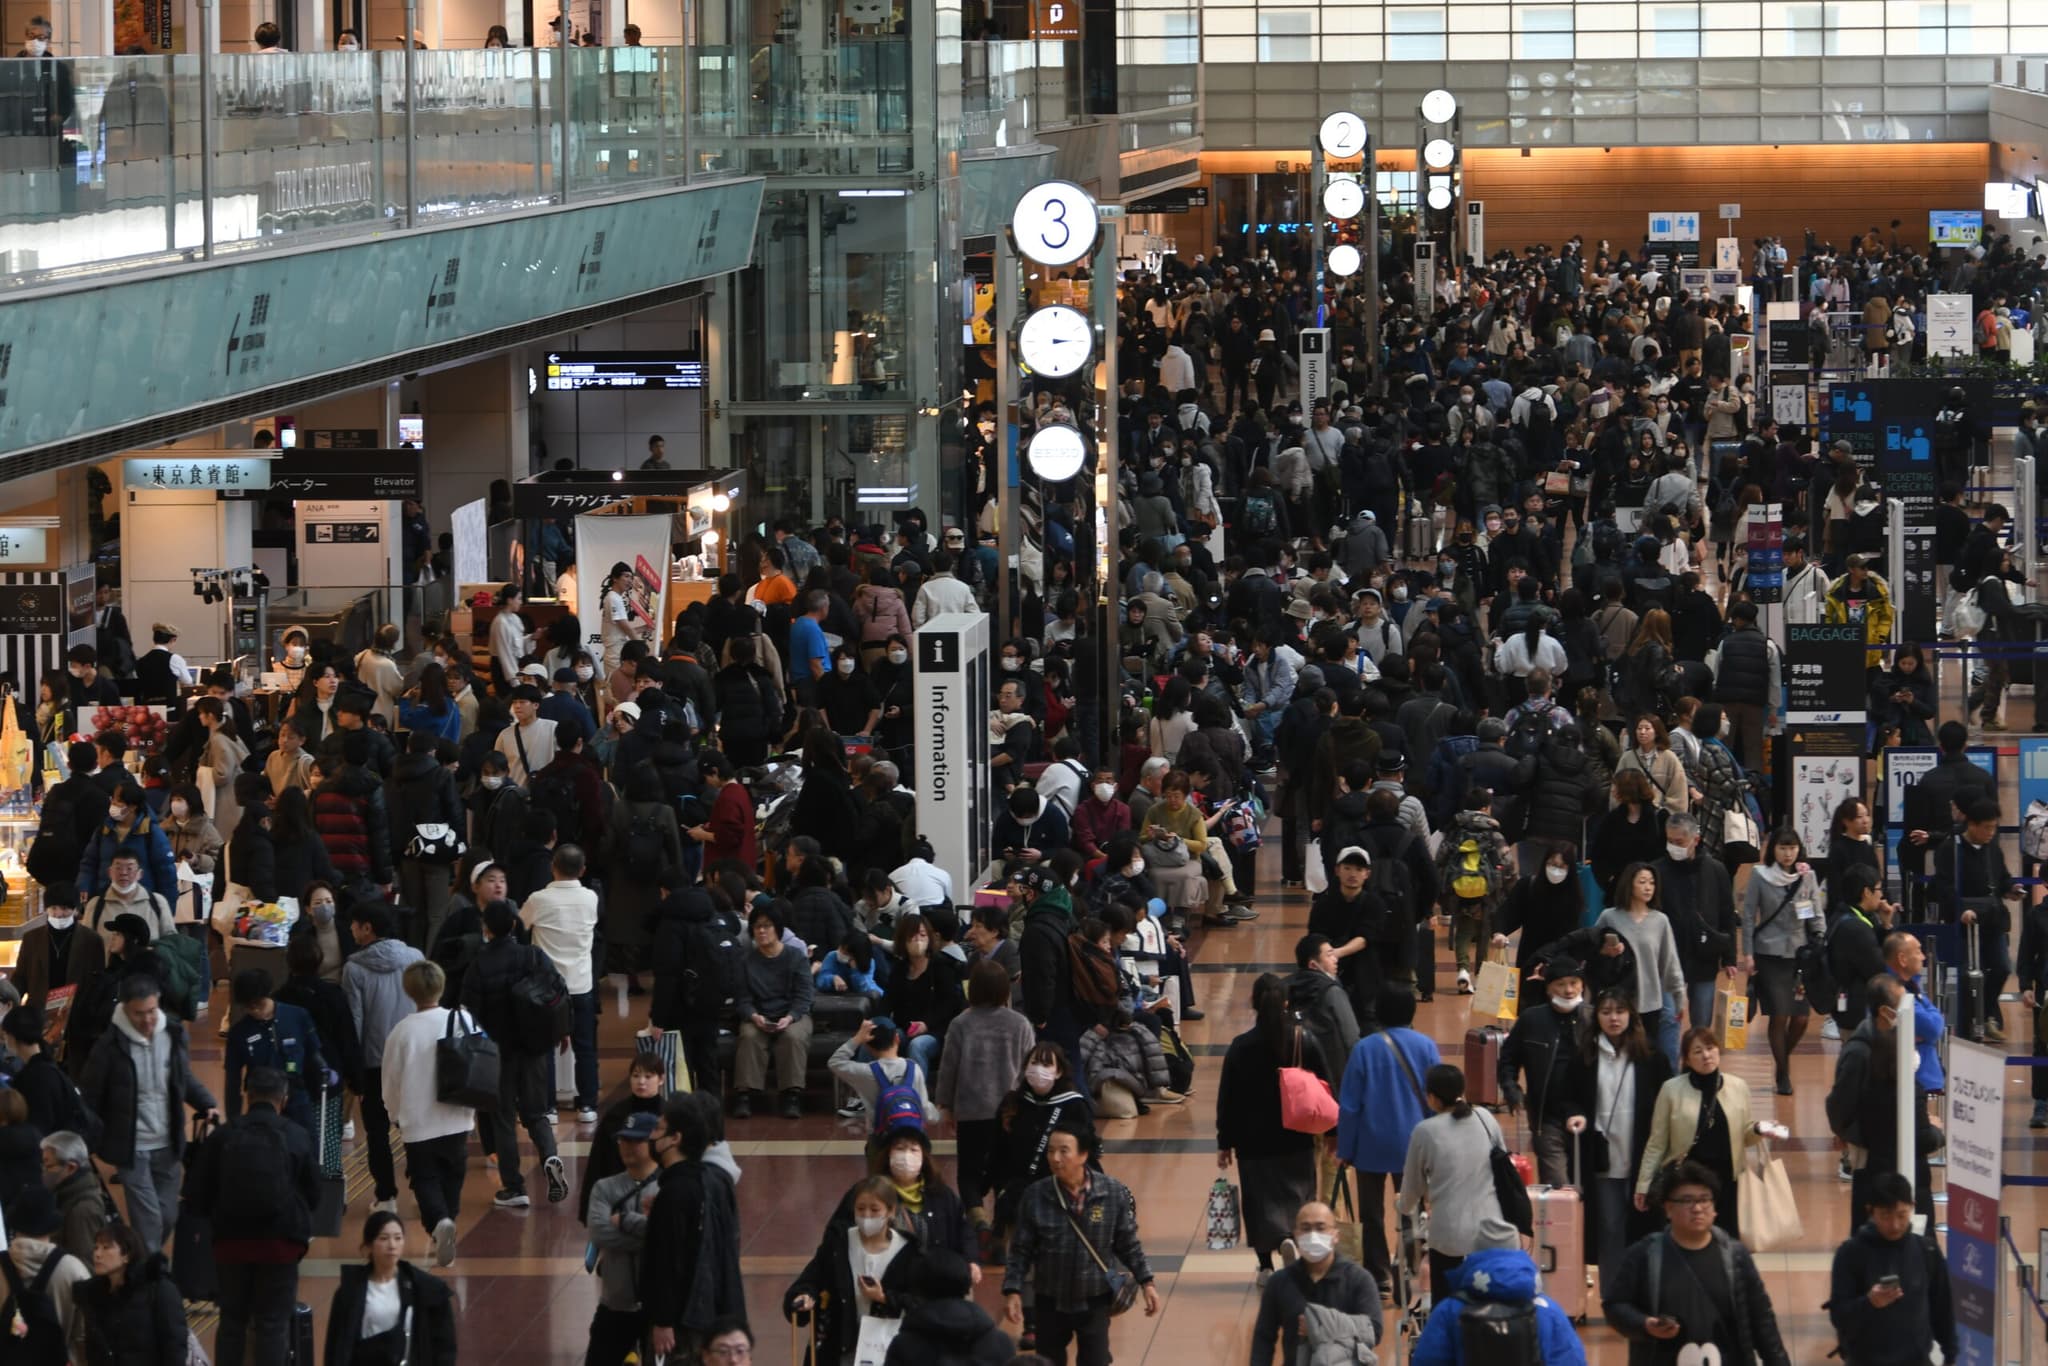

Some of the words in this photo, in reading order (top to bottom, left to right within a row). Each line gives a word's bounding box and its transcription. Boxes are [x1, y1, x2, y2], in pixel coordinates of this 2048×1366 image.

[1336, 120, 1351, 148] 2
[1041, 199, 1070, 249] 3
[373, 477, 416, 486] Elevator
[306, 504, 325, 512] ANA
[1791, 627, 1860, 641] BAGGAGE
[1791, 664, 1823, 674] 手荷物
[932, 685, 950, 801] Information
[1893, 770, 1915, 787] 10
